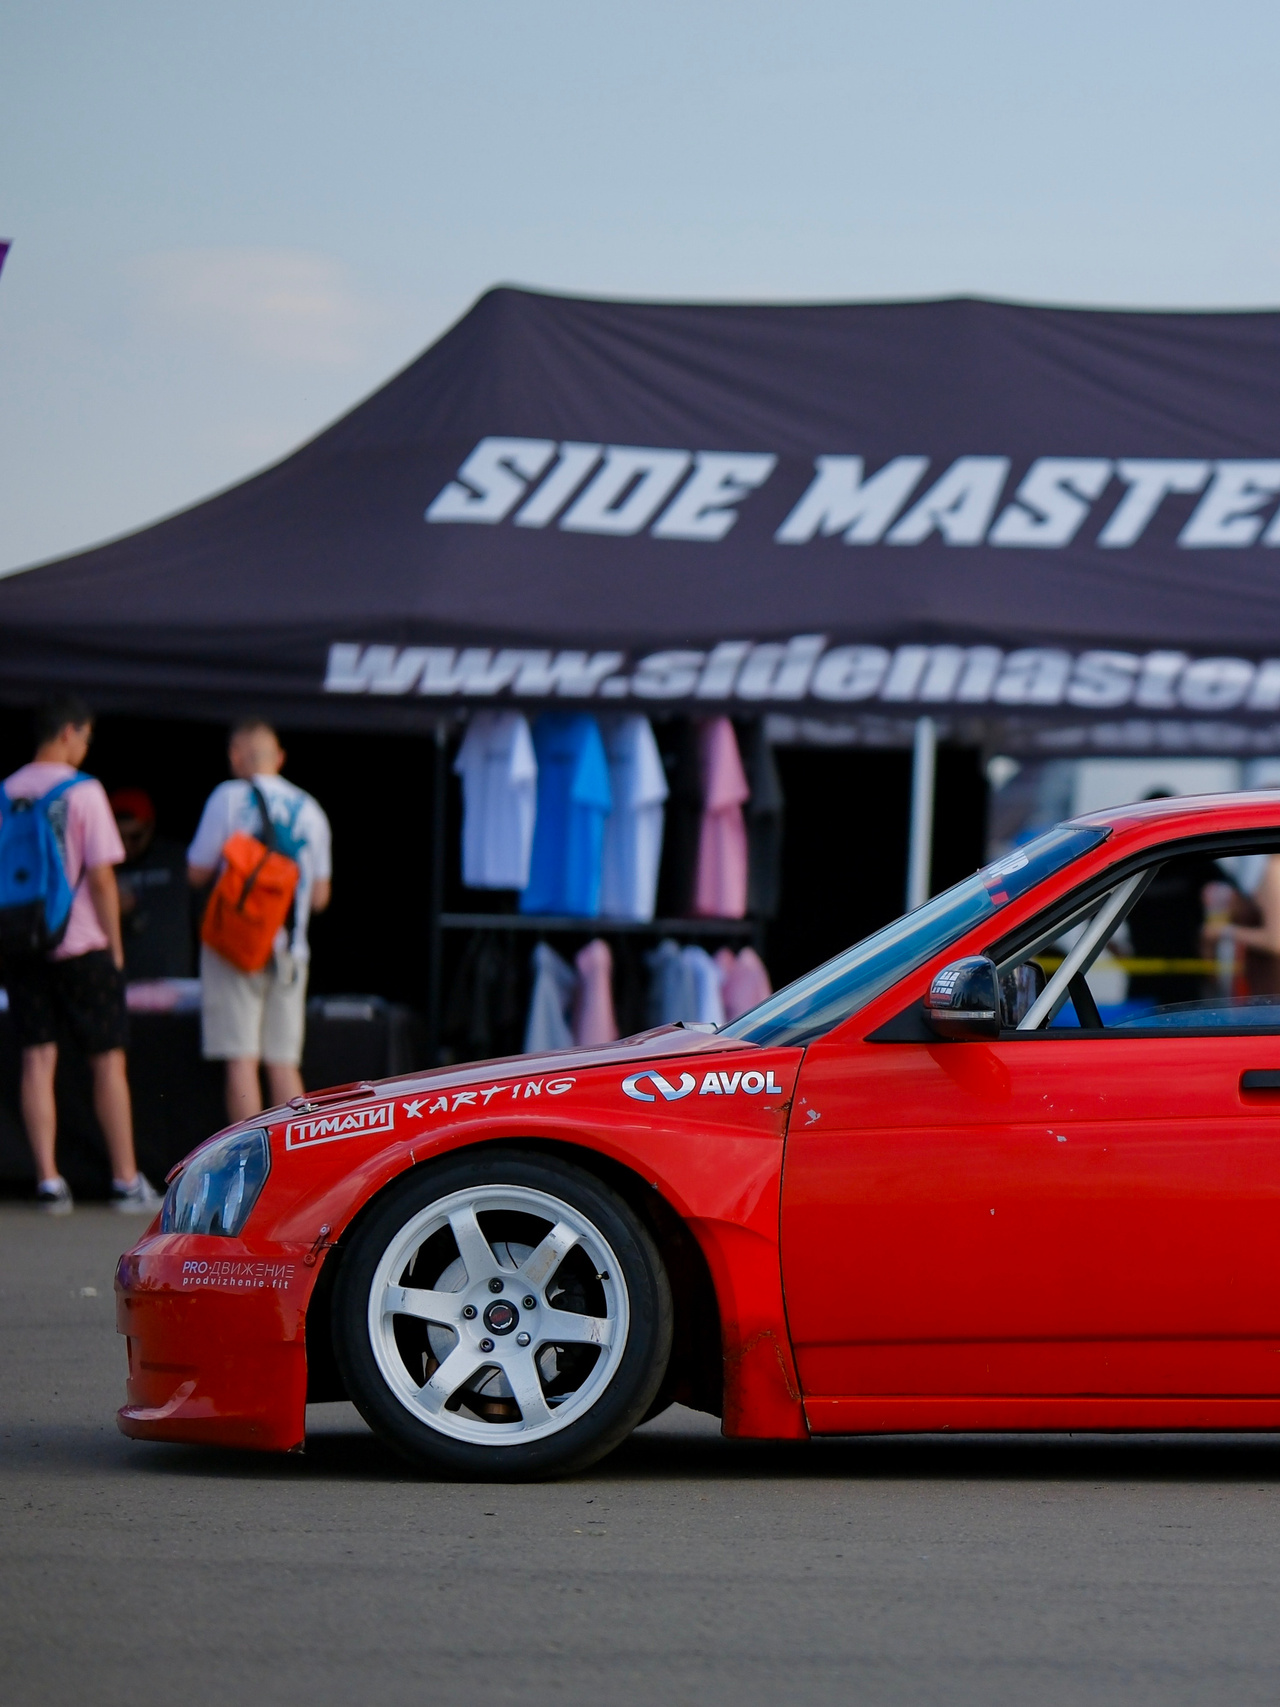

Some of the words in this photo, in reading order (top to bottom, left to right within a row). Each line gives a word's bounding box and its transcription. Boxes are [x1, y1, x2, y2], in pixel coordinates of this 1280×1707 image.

[425, 436, 778, 542] SIDE
[402, 1077, 577, 1119] KARTING
[699, 1070, 782, 1095] AVOL
[182, 1276, 289, 1289] prodvizhenie.fit
